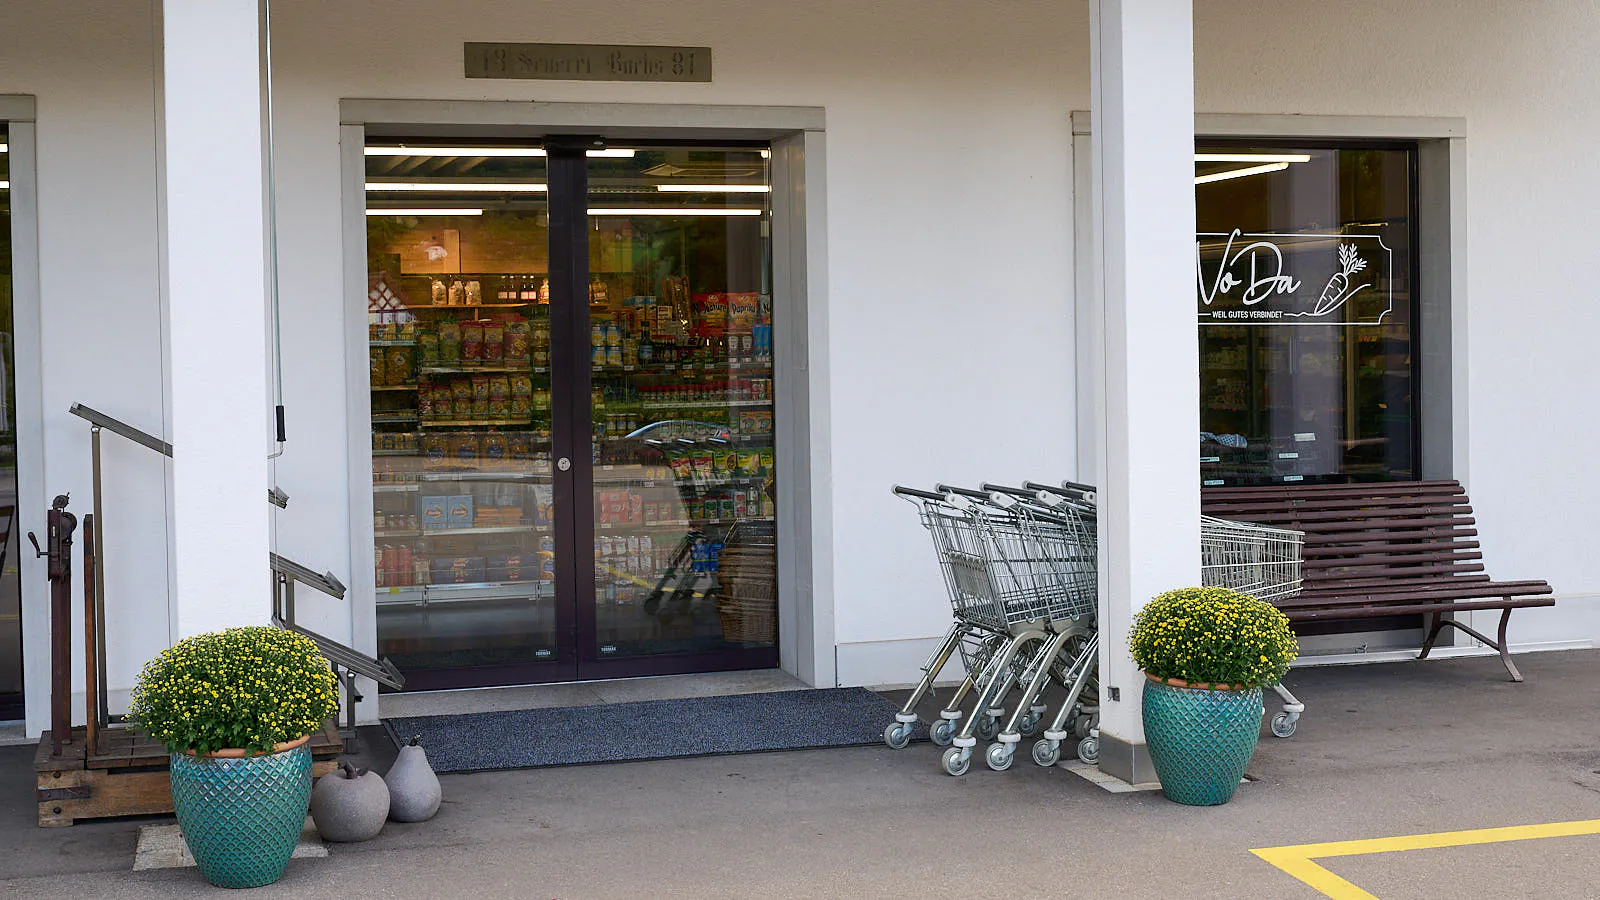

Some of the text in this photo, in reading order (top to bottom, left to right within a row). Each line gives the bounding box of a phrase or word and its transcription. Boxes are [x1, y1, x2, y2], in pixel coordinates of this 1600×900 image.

[672, 52, 694, 76] 81
[1212, 310, 1283, 319] WEIL GUTES VERBINDET
